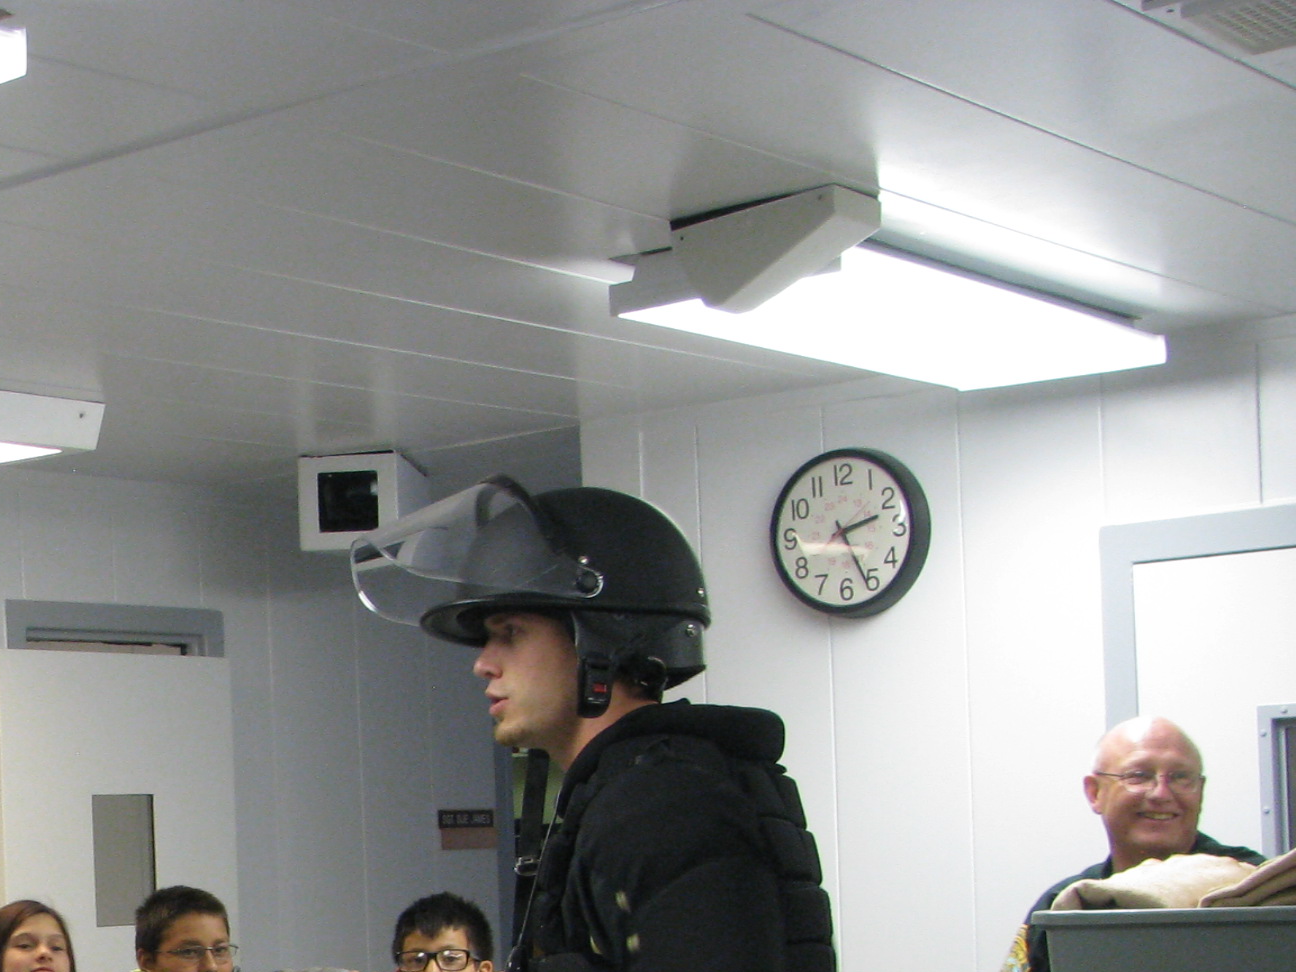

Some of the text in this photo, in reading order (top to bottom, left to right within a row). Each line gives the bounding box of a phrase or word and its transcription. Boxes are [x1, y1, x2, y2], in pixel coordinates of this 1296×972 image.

[834, 463, 853, 486] 12
[868, 469, 873, 490] 1
[811, 475, 823, 498] 11
[881, 486, 896, 510] 2
[791, 498, 810, 521] 10
[892, 513, 907, 537] 3
[783, 528, 798, 550] 9
[795, 556, 809, 579] 8
[883, 546, 898, 569] 4
[814, 574, 829, 596] 7
[839, 578, 854, 601] 6
[865, 568, 881, 591] 5
